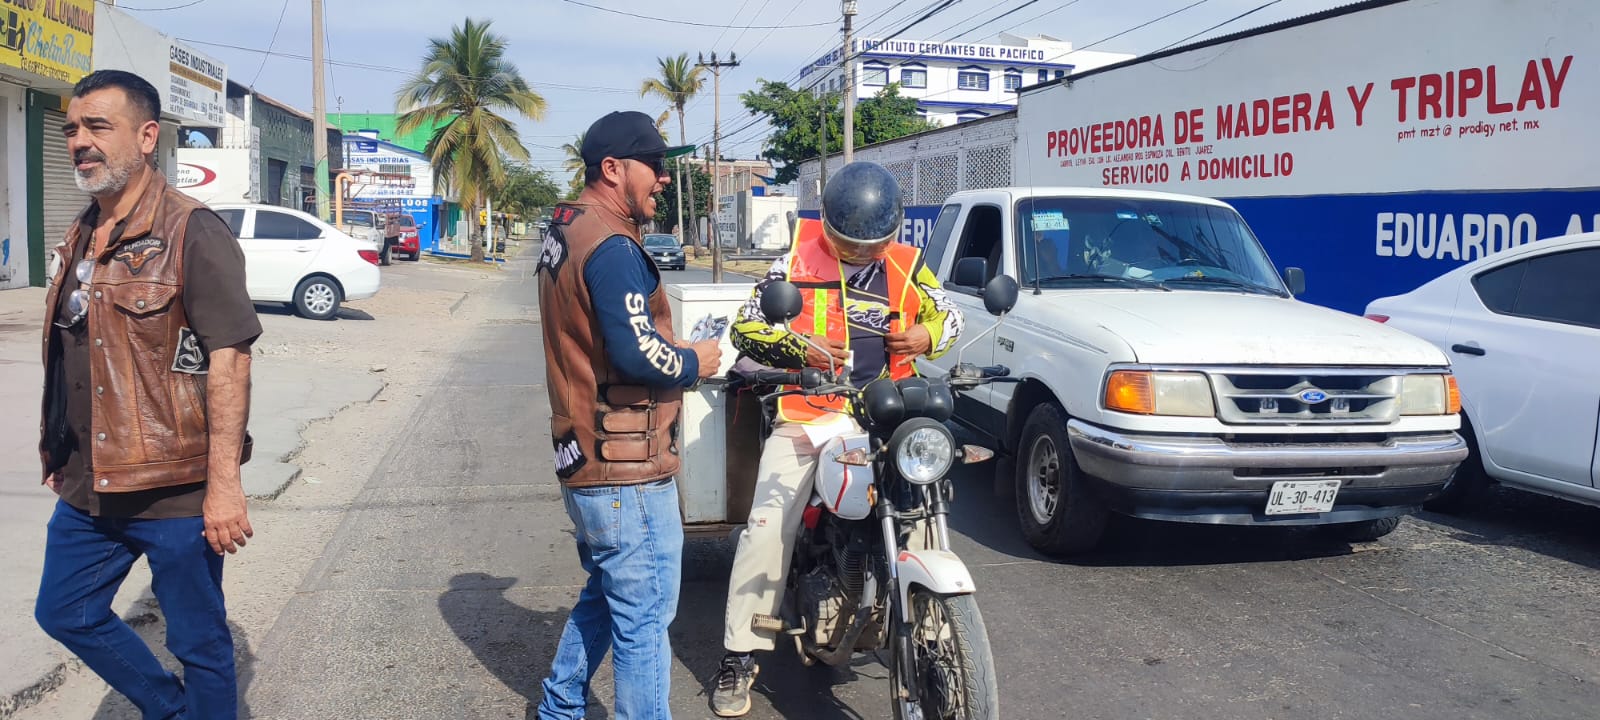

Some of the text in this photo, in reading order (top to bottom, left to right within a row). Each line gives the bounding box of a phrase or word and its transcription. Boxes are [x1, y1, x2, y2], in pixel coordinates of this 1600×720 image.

[862, 39, 1044, 61] INSTITUTO CERVANTES DEL PACIFICO
[169, 45, 190, 66] GASES
[190, 54, 223, 81] INDUSTRIALES
[1047, 55, 1574, 158] PROVEEDORA DE MADERA Y TRIPLAY
[1397, 126, 1416, 143] pmt
[1458, 121, 1496, 139] prodigy
[1523, 120, 1540, 130] mx
[1195, 145, 1214, 155] JUAREZ
[1102, 152, 1294, 186] SERVICIO A DOMICILIO
[123, 238, 161, 251] FUNDADOR
[1375, 212, 1538, 261] EDUARDO
[1271, 489, 1335, 506] UL-30-413
